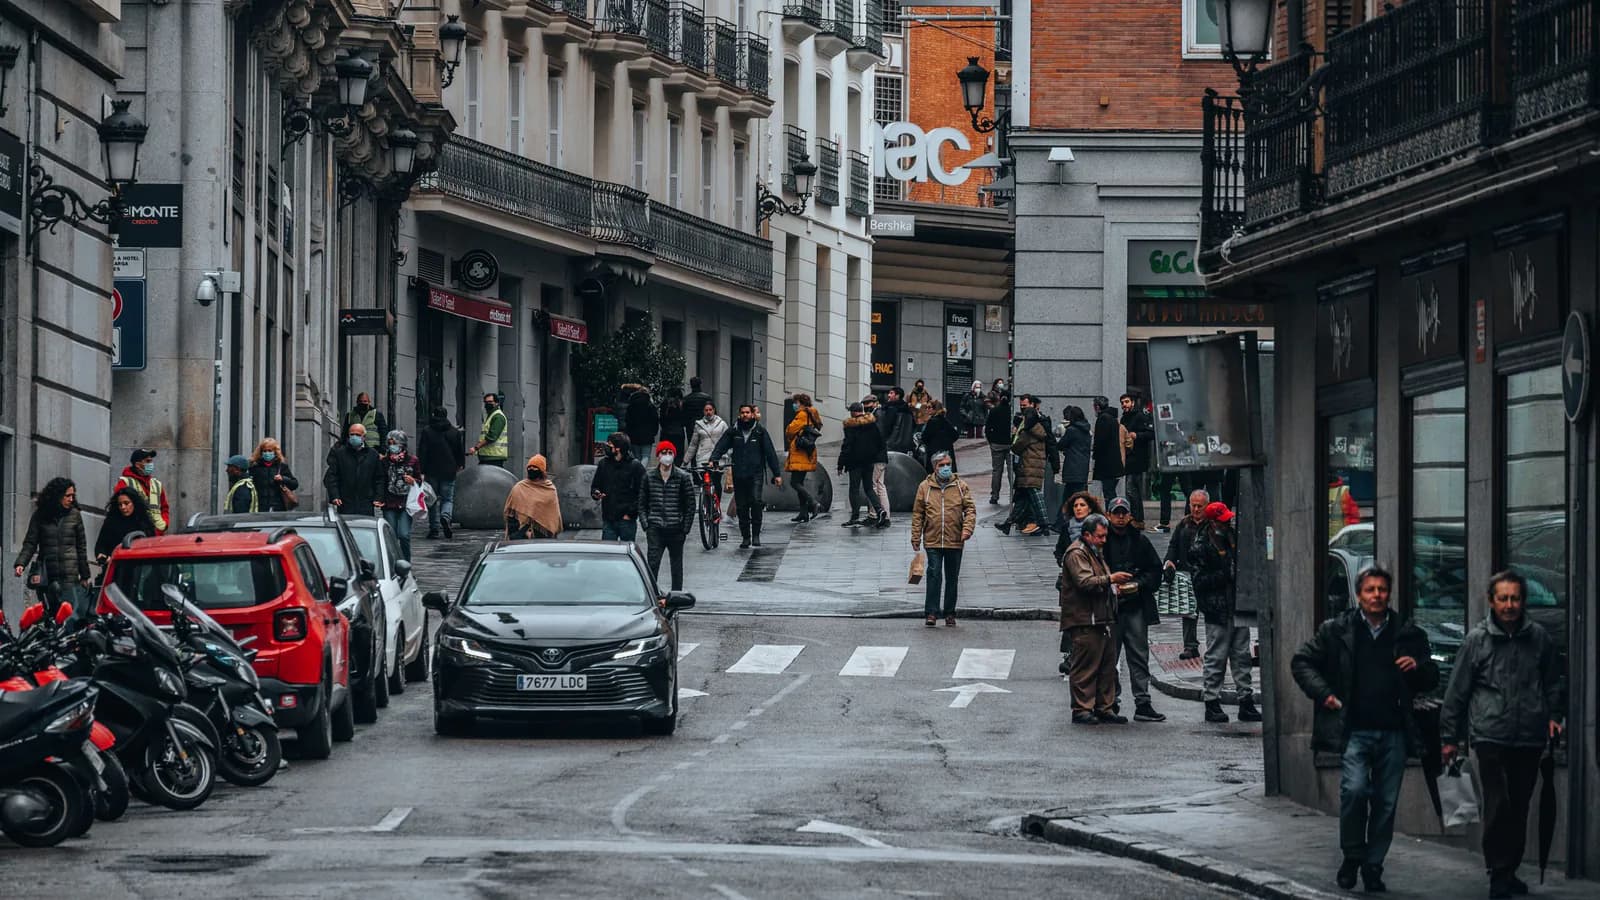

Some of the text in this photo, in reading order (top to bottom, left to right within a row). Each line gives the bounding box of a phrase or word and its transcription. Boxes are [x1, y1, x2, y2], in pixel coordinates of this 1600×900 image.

[870, 219, 912, 231] Bershka
[952, 314, 968, 324] fnac
[874, 363, 894, 374] FNAC
[526, 677, 584, 689] 7677 LDC
